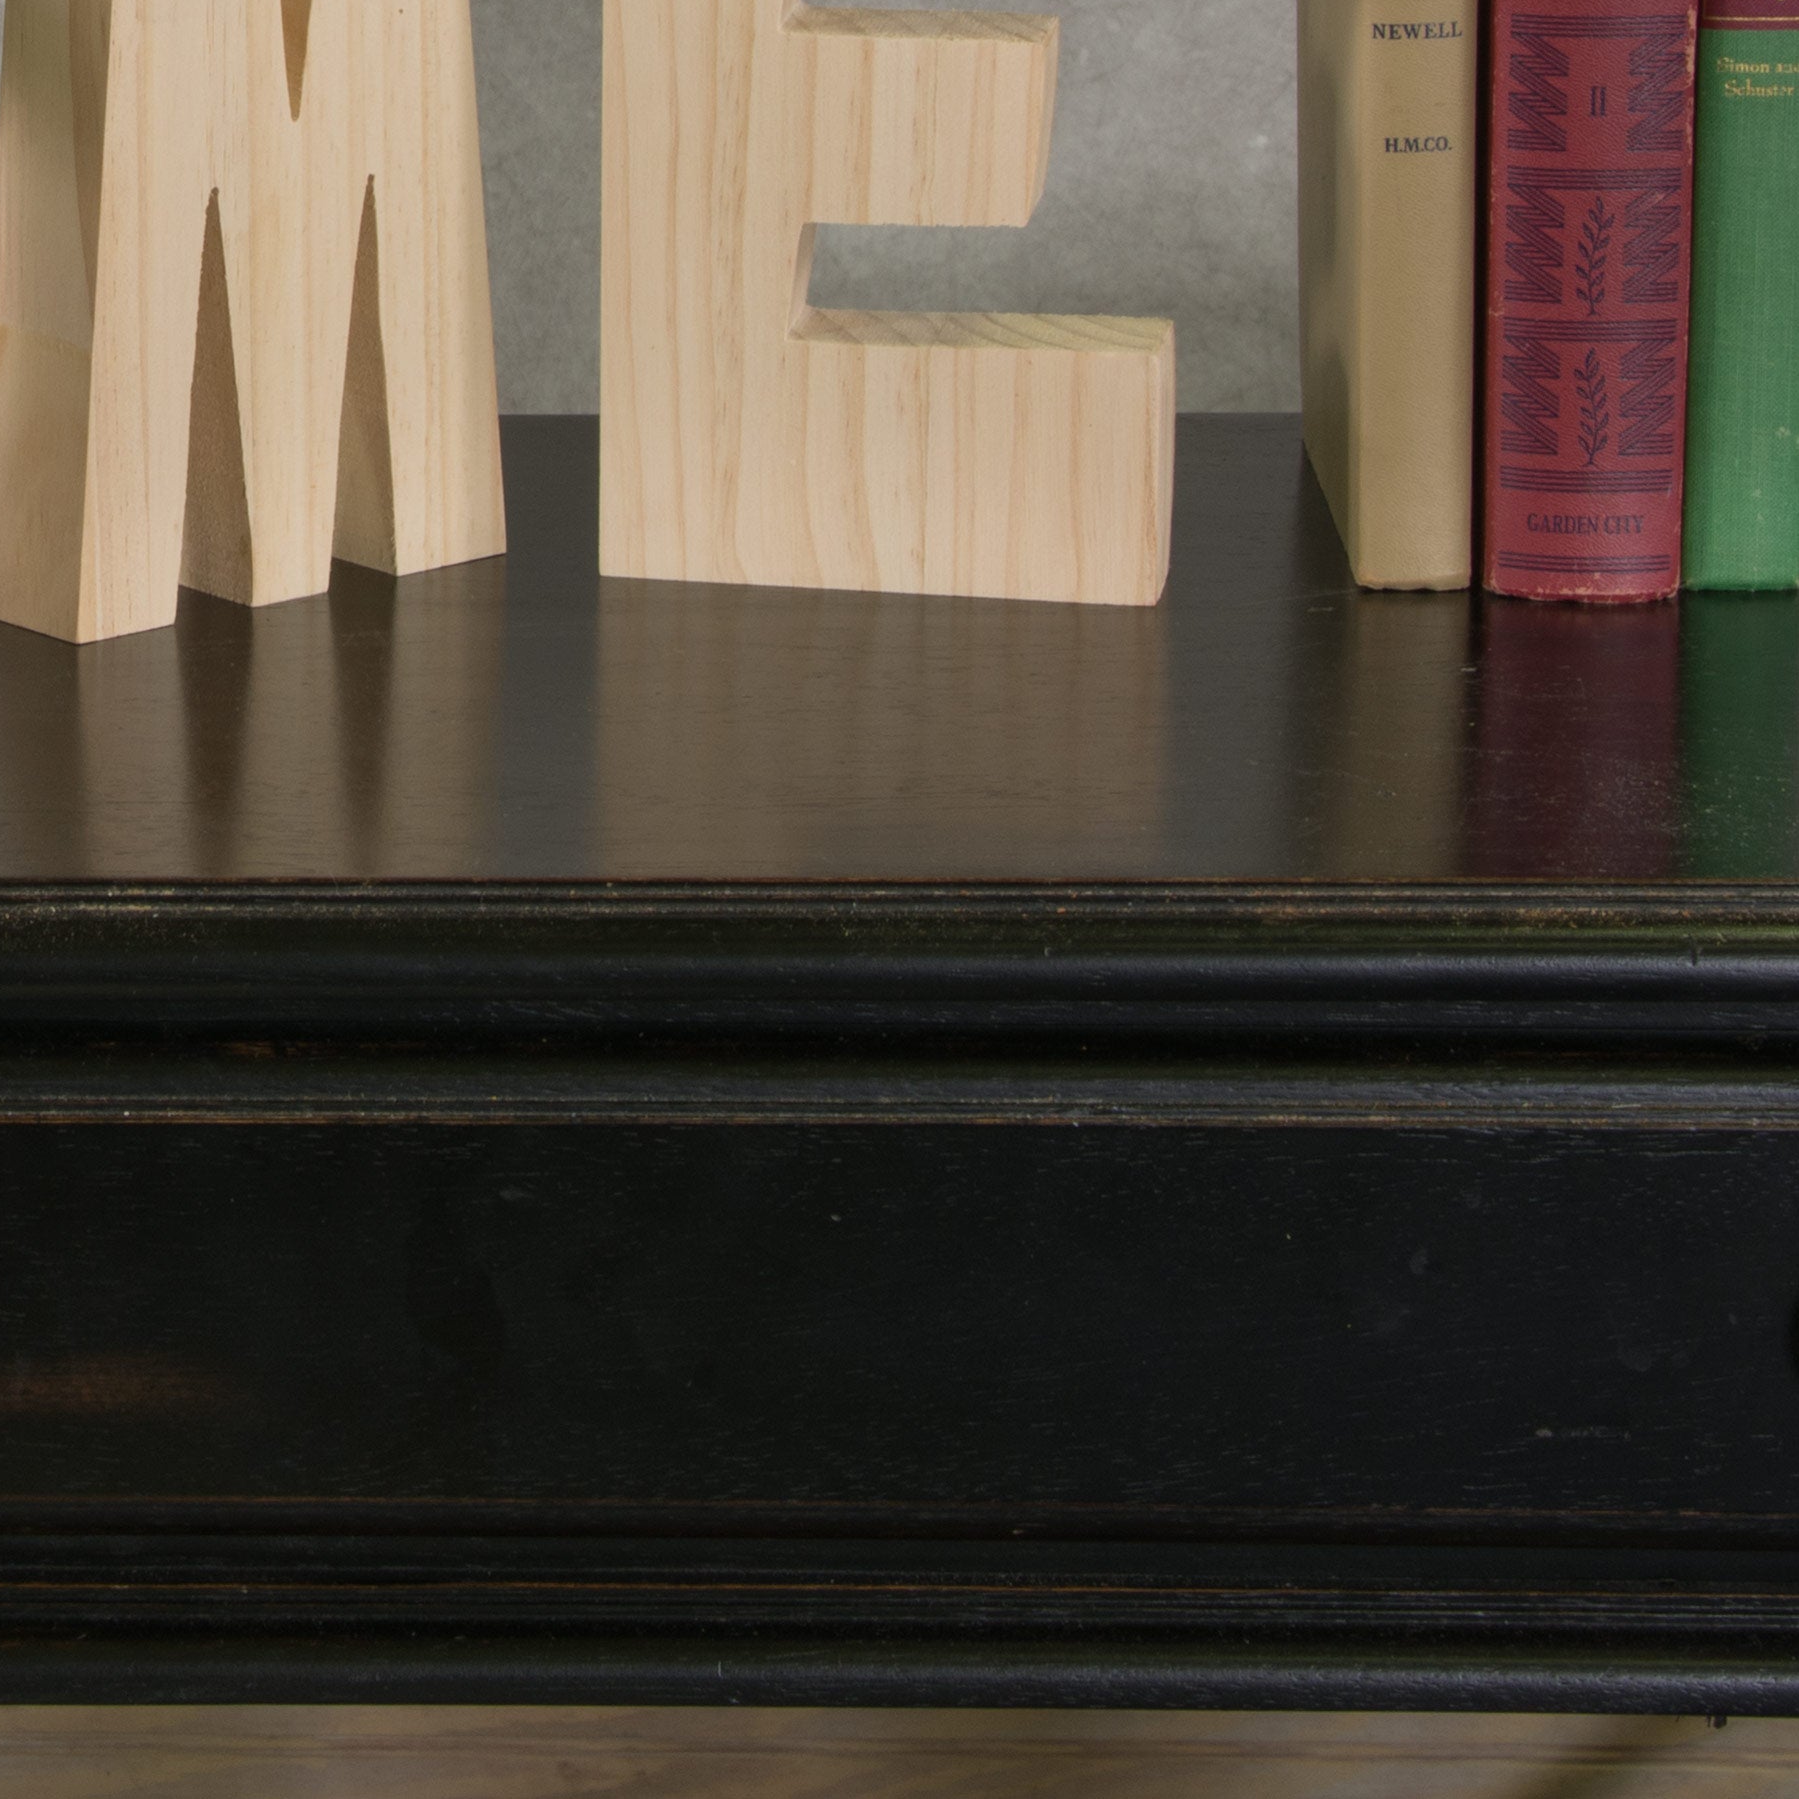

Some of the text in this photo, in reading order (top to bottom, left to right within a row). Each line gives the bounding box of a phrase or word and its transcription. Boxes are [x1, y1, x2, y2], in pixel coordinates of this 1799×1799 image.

[1371, 21, 1463, 40] NEWELL
[1717, 57, 1770, 73] Simon
[1590, 86, 1607, 117] II
[1384, 136, 1453, 153] H.M.CO.
[1527, 513, 1644, 535] GARDEN CITY
